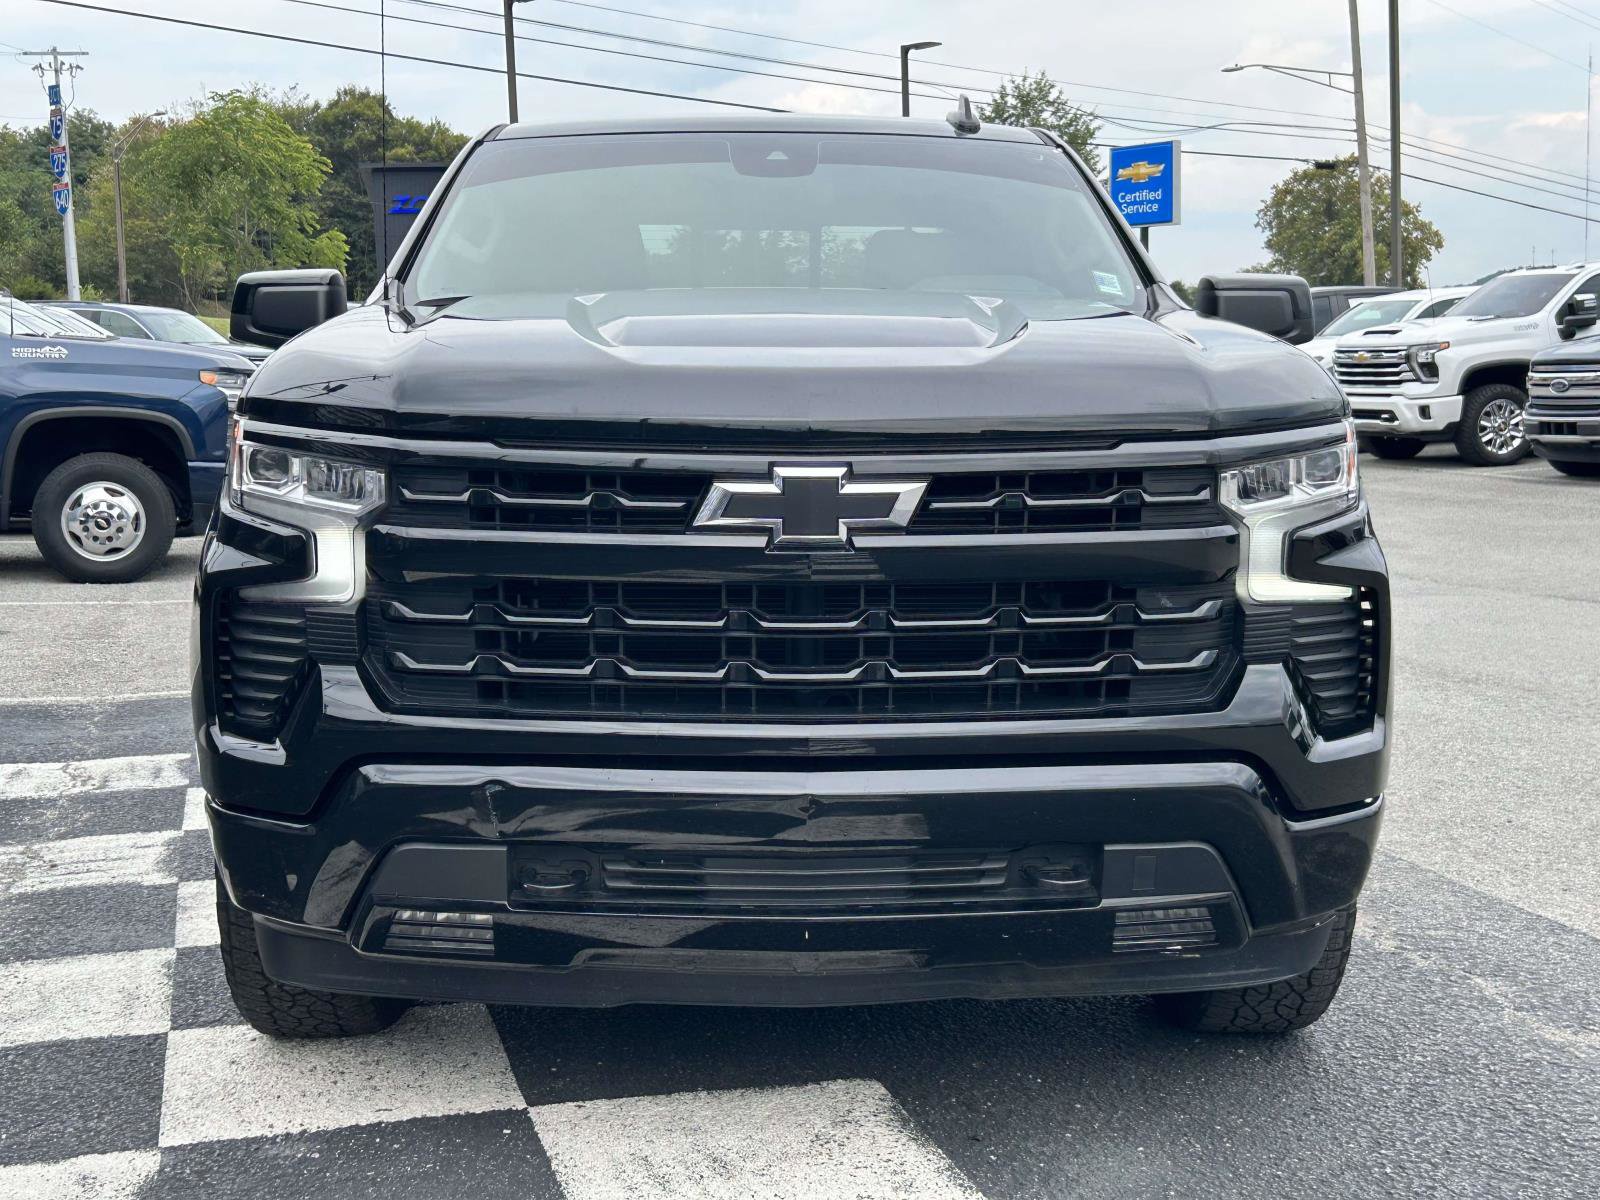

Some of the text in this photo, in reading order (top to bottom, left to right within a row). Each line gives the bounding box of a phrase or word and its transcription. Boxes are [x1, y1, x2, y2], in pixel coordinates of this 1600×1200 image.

[51, 116, 62, 135] 75
[53, 153, 66, 172] 275
[55, 190, 69, 210] 640
[1118, 188, 1162, 203] Certified
[1121, 202, 1159, 214] Service
